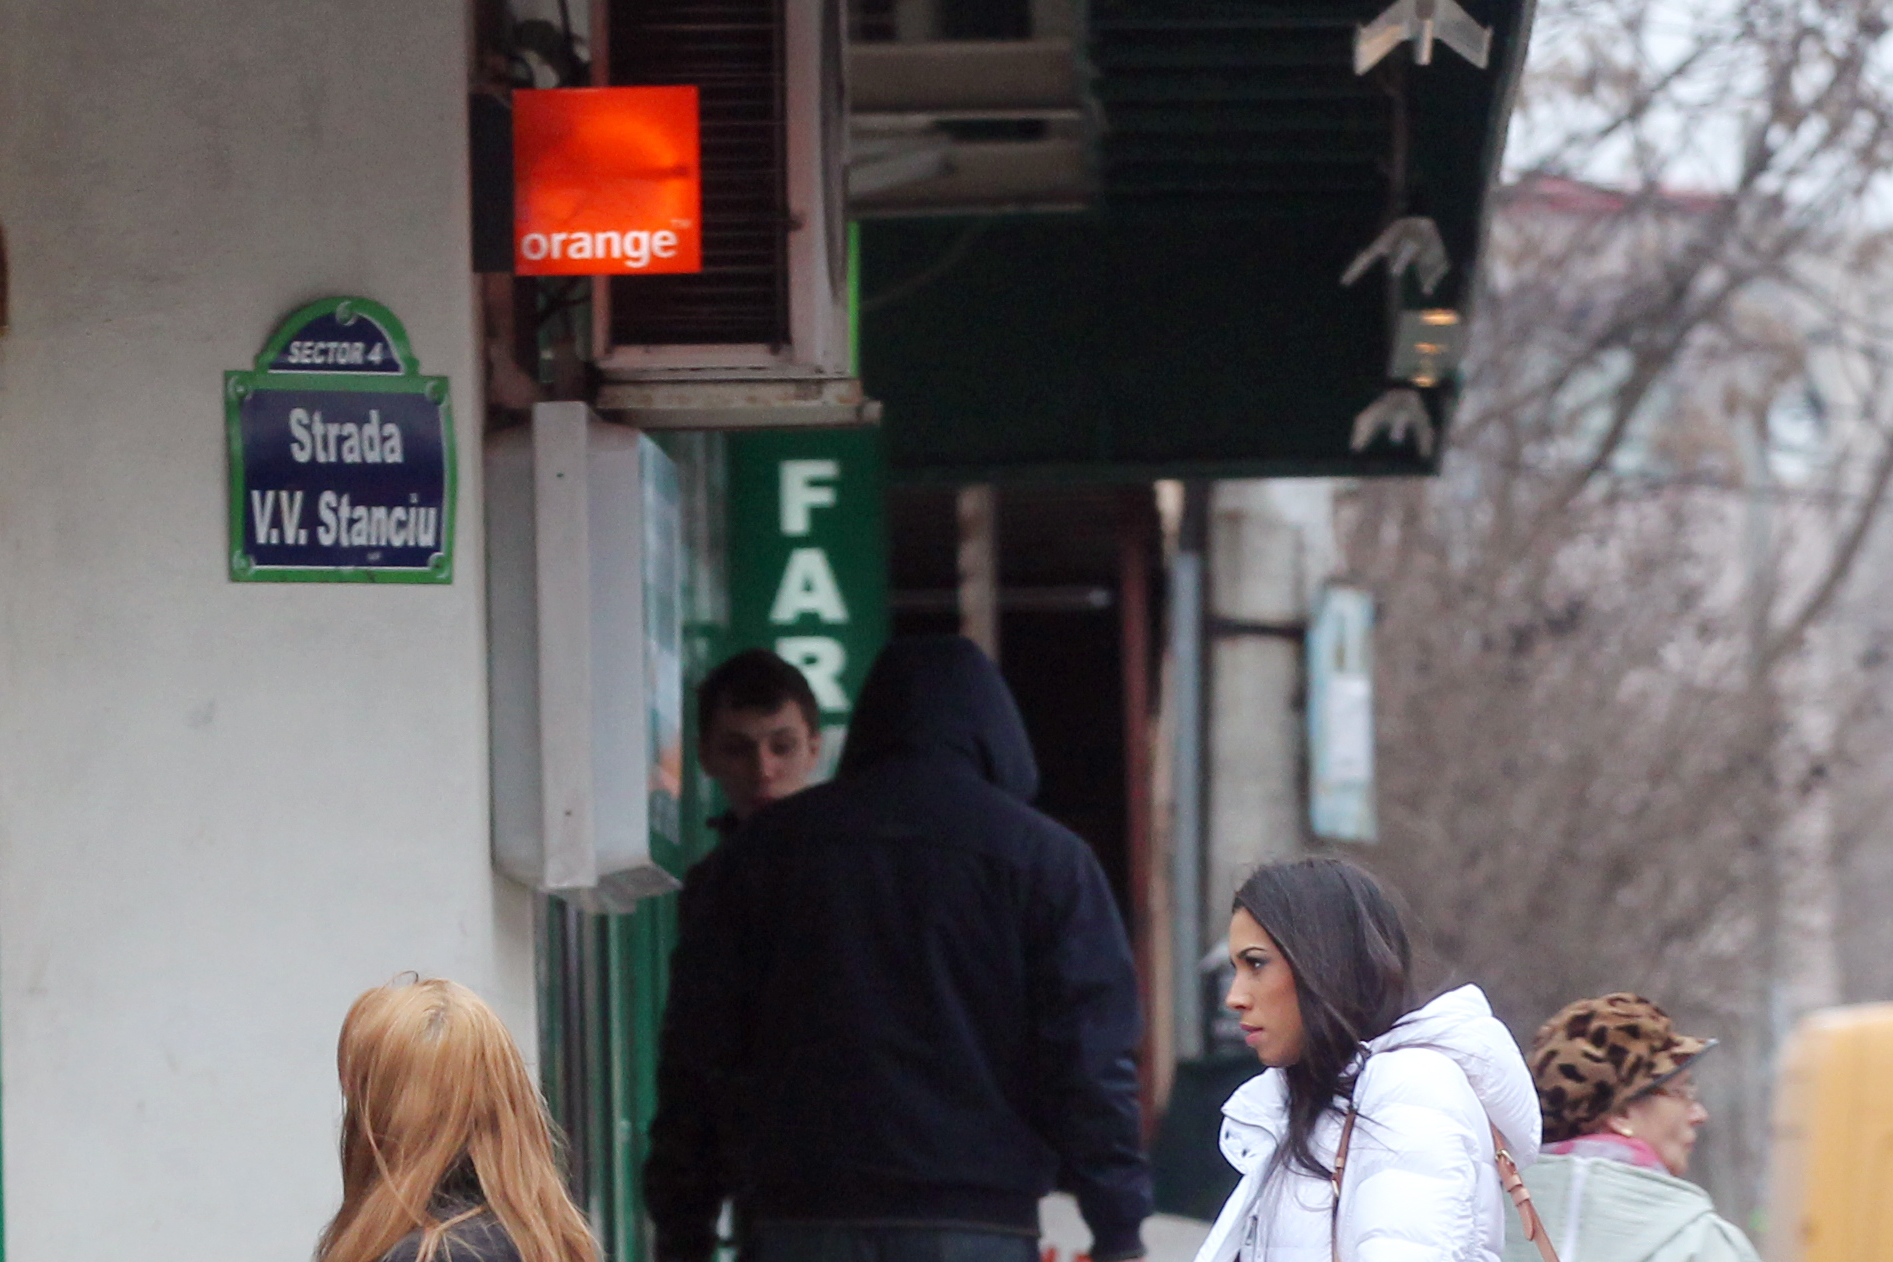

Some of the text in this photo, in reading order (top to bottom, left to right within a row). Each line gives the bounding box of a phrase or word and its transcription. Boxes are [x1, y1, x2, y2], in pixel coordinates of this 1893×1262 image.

[521, 229, 678, 268] orange
[288, 341, 383, 364] SECTOR 4
[289, 407, 403, 463] Strada
[251, 489, 437, 548] V.V. Stanciu
